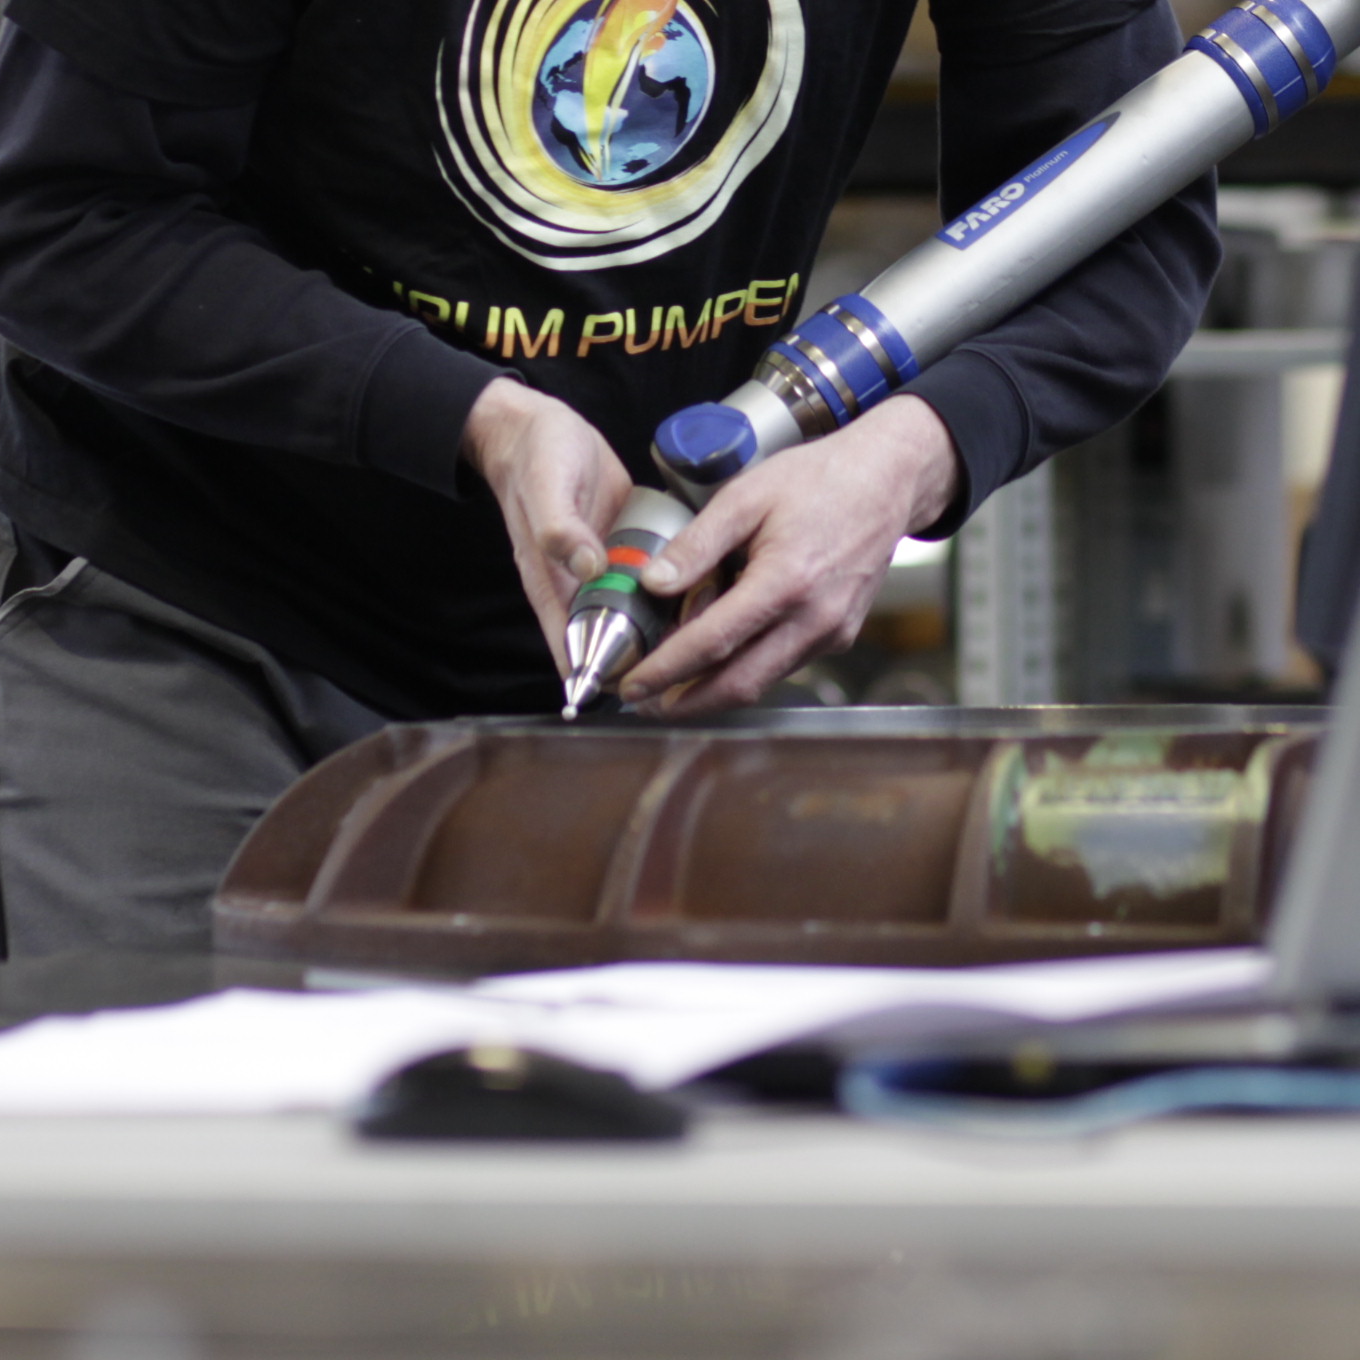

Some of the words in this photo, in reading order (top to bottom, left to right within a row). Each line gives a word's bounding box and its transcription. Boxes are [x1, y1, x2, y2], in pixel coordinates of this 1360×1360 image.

[945, 182, 1025, 241] FARO
[1023, 149, 1069, 183] Platinum
[363, 265, 565, 359] RUM
